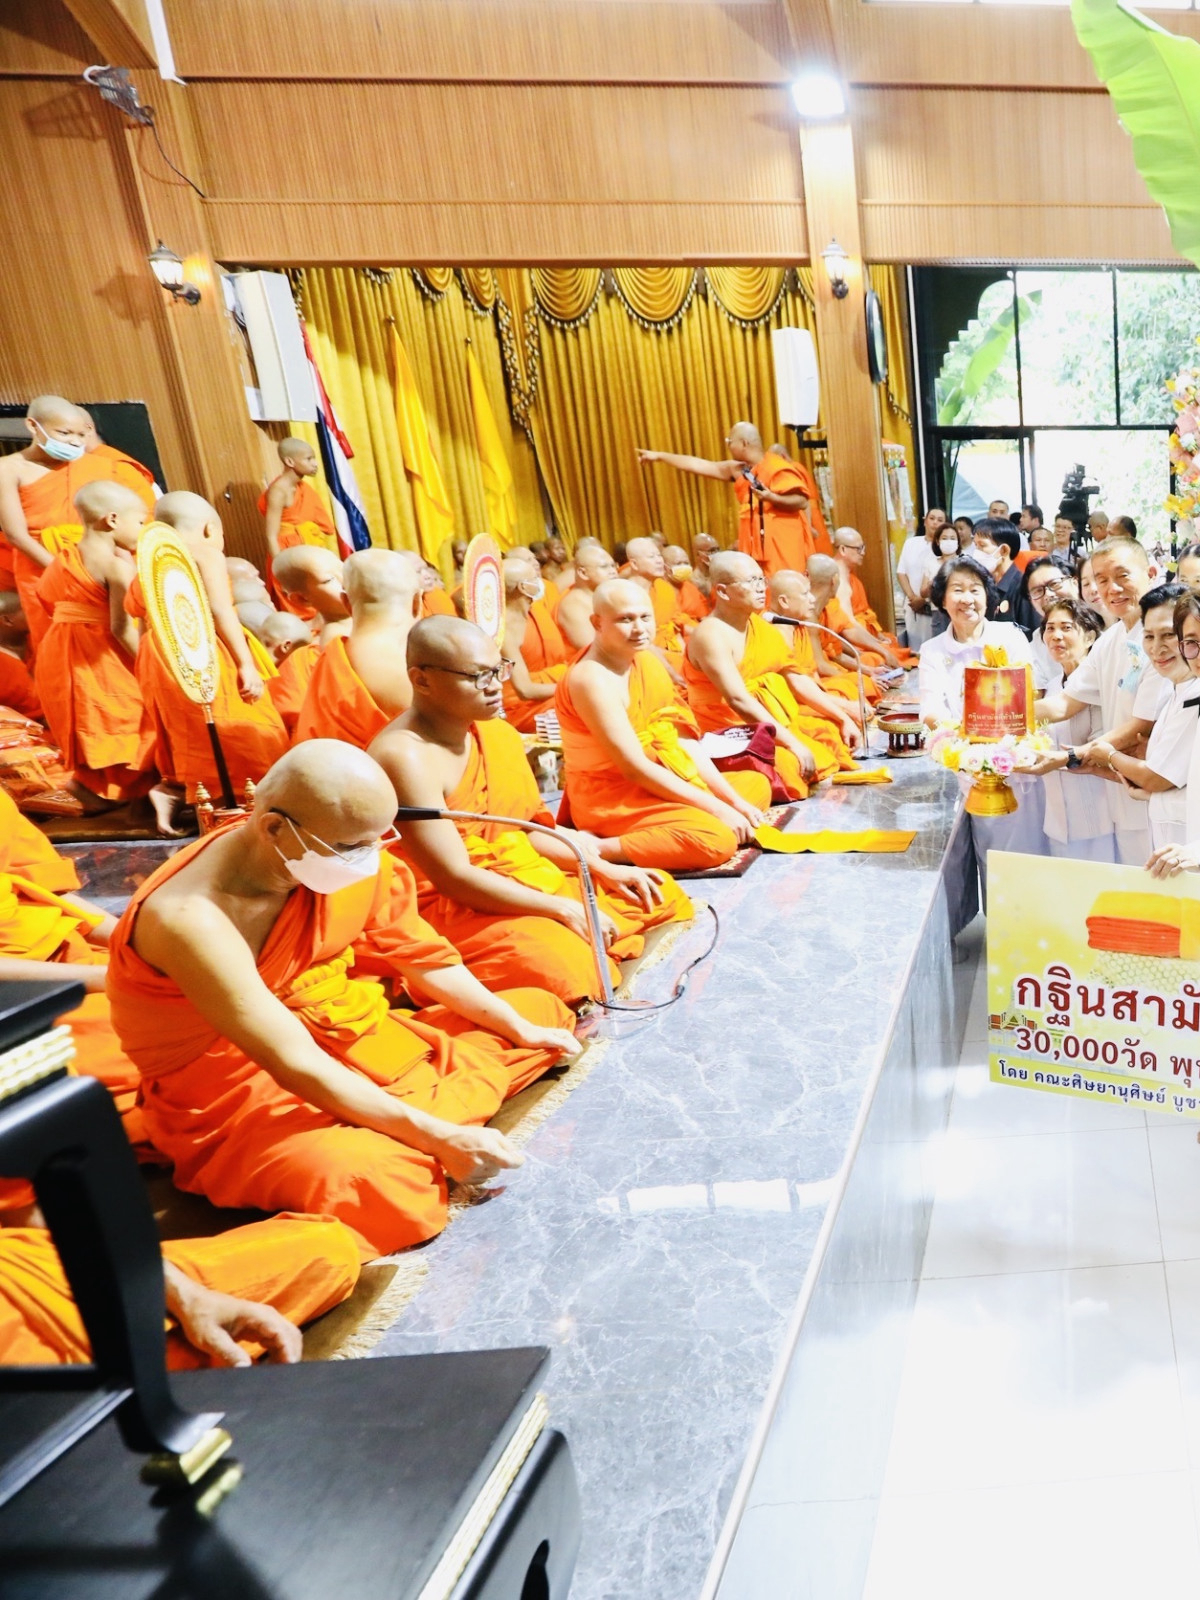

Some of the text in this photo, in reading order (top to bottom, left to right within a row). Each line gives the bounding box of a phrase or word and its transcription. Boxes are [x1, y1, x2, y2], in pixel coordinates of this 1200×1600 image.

[1016, 1027, 1157, 1072] 30,000วัด
[999, 1060, 1028, 1080] โดย
[1035, 1071, 1167, 1103] คณะศิษยานุศิษย์
